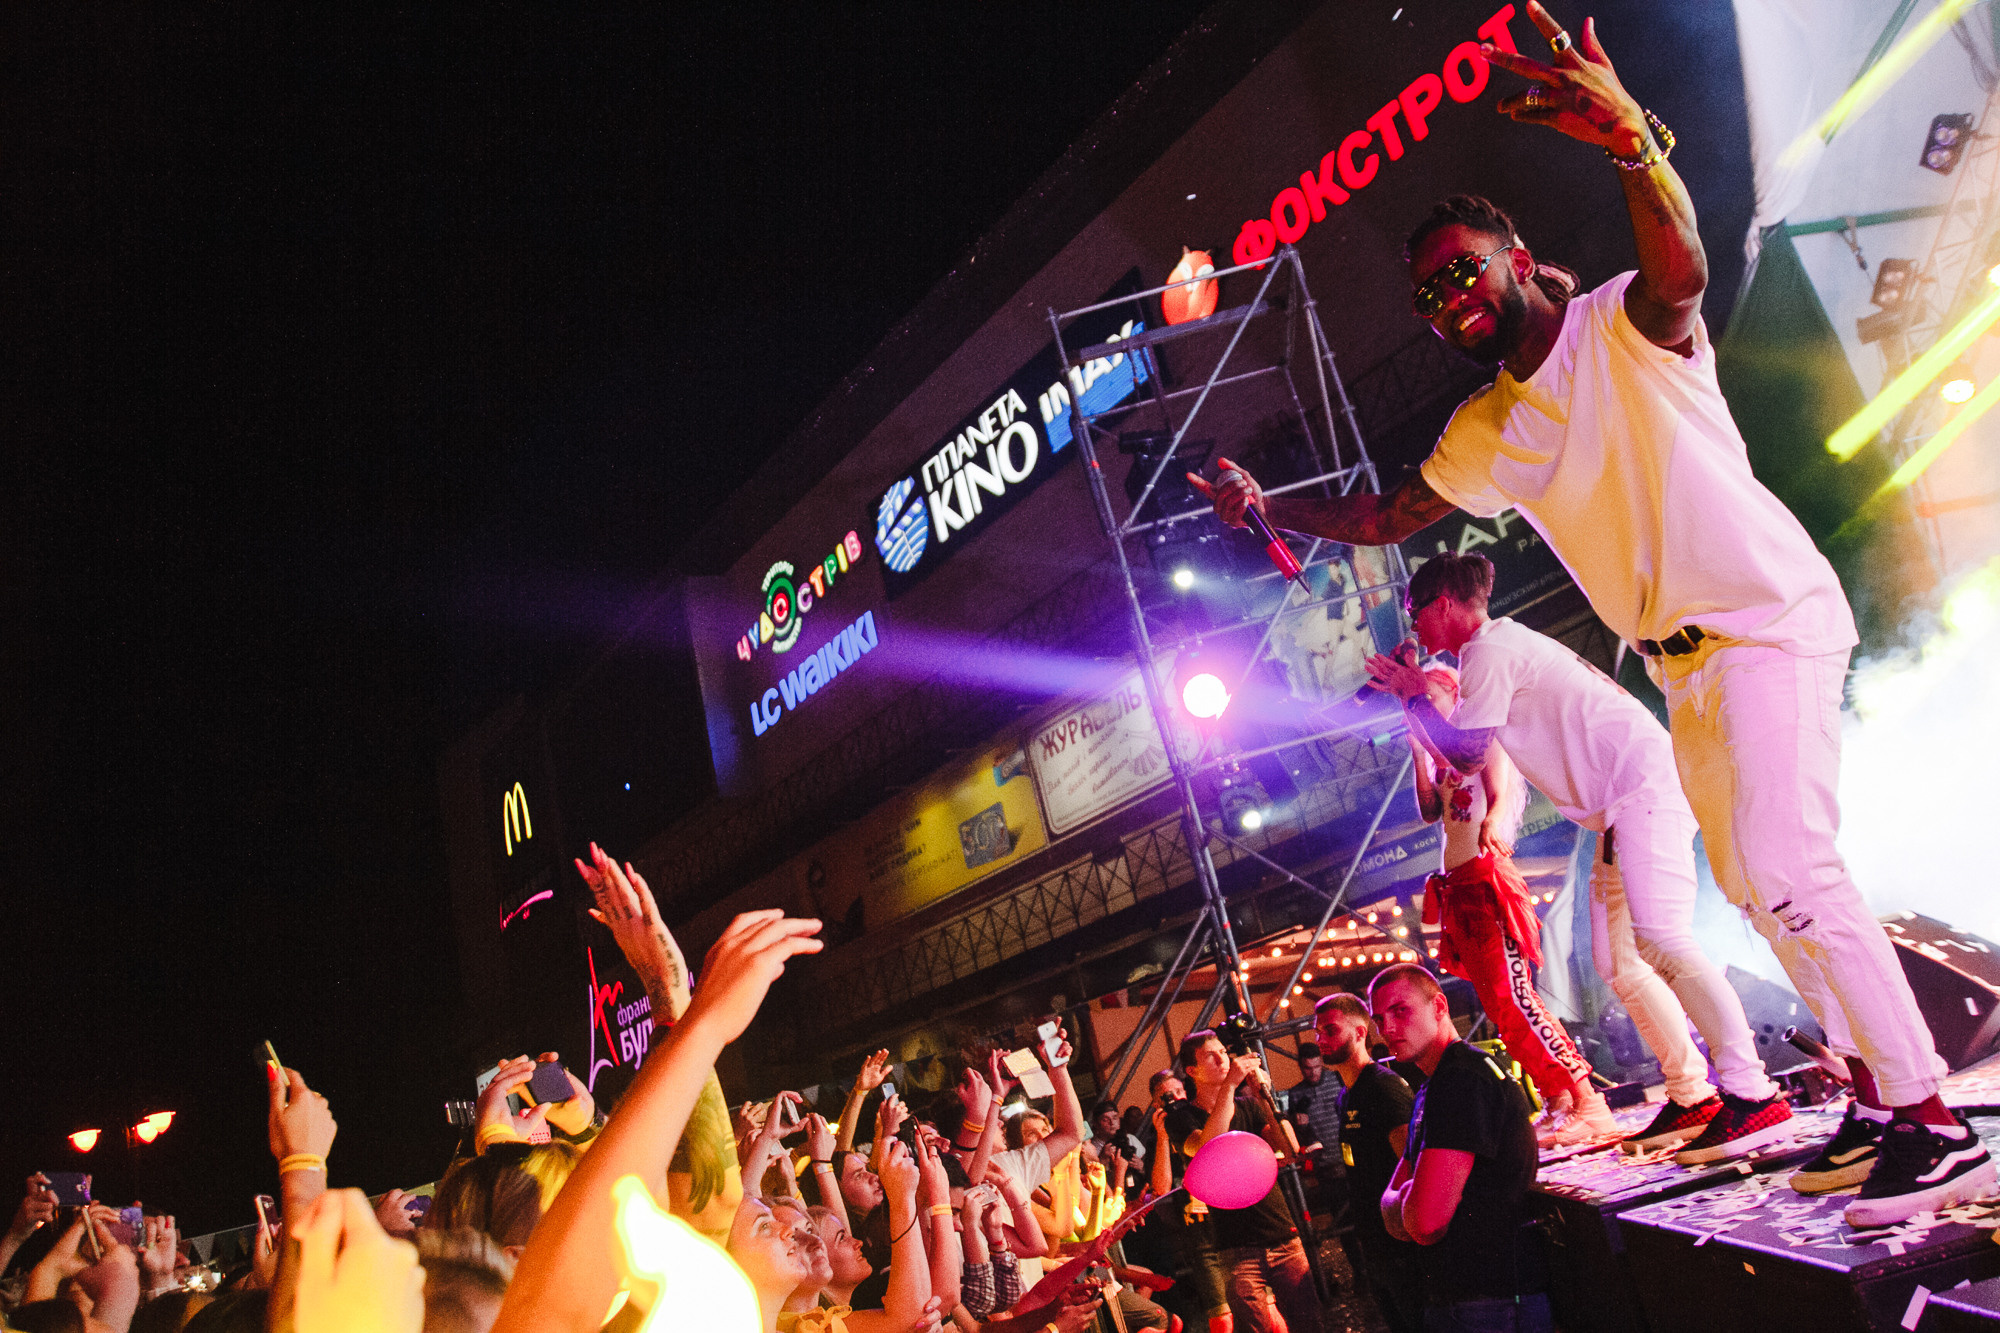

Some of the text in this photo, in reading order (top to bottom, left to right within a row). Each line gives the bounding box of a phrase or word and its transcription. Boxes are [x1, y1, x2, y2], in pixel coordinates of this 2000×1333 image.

[1232, 3, 1518, 270] ФОКСТРОТ
[928, 421, 1039, 543] KINO
[750, 701, 782, 737] LC
